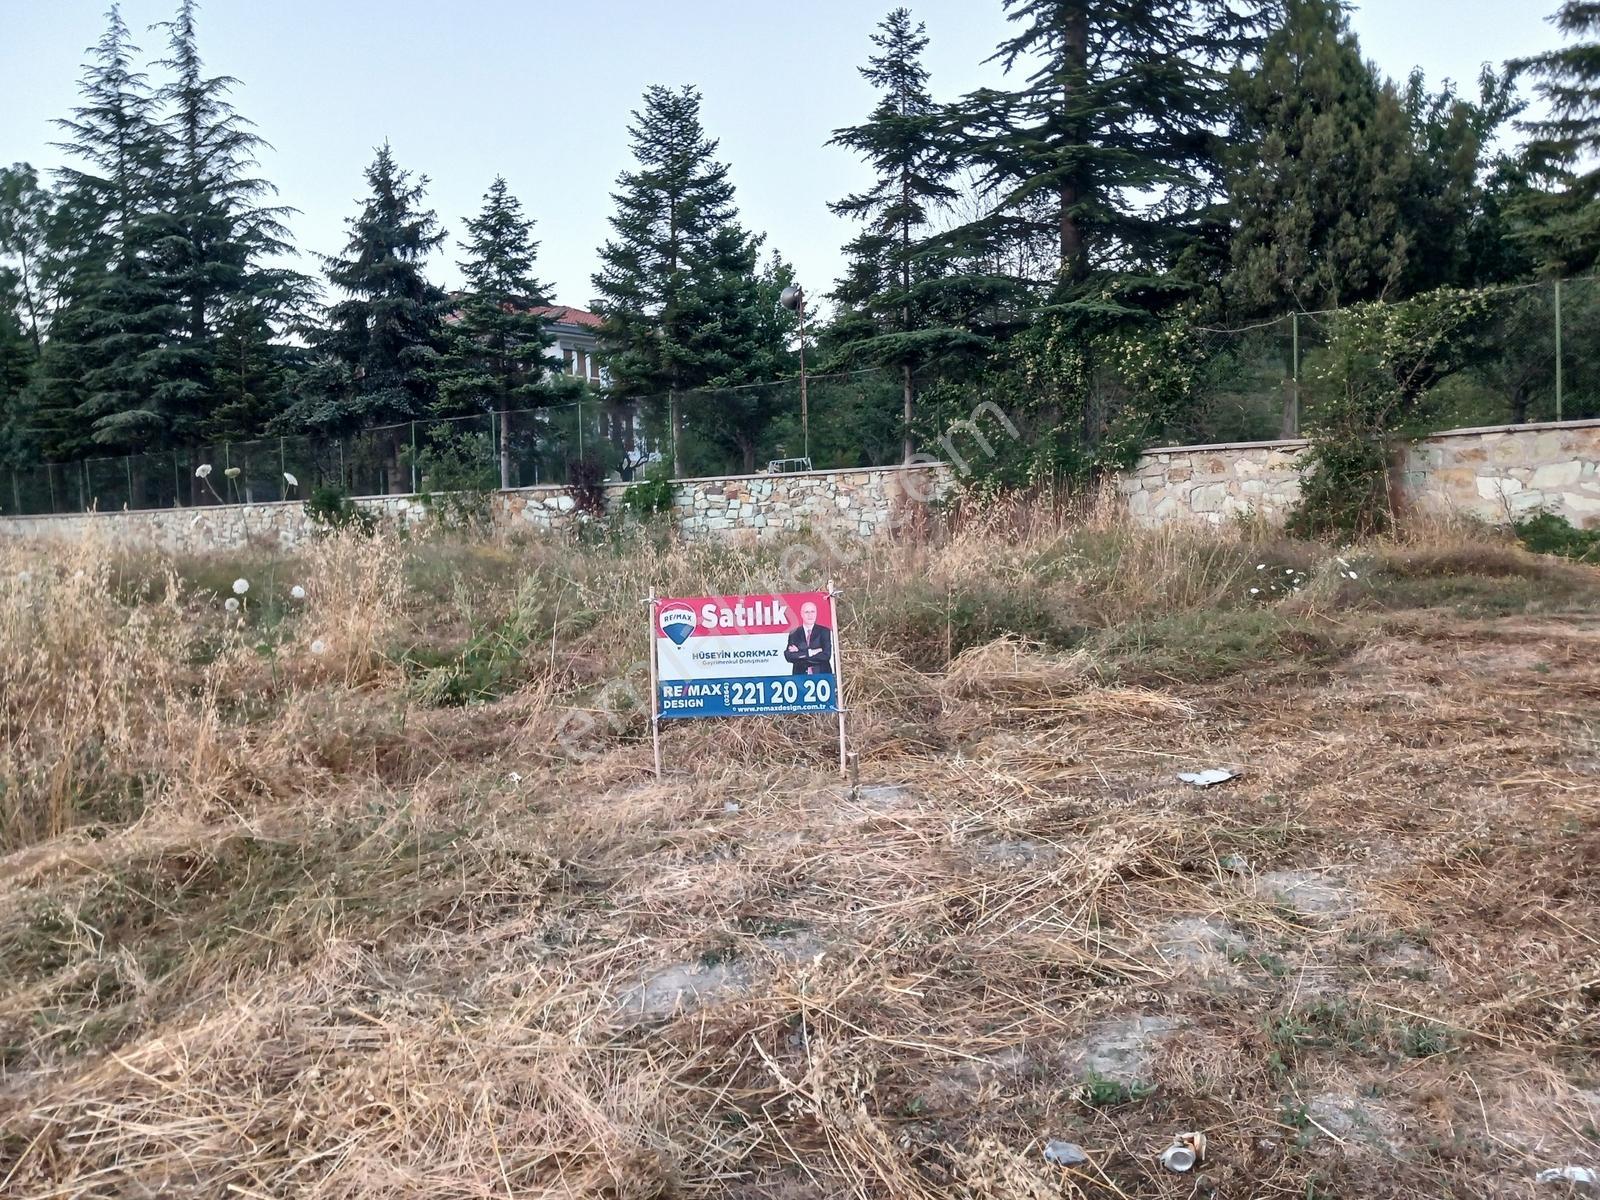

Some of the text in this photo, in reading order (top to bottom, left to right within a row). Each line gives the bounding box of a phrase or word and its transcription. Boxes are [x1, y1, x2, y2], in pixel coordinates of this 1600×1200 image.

[664, 613, 692, 622] RE/MAX
[702, 600, 789, 629] Satılık
[692, 649, 779, 660] HÜSEYİN KORKMAZ
[663, 683, 722, 698] RE/MAX
[731, 679, 831, 705] 221 20 20
[663, 698, 704, 709] DESIGN
[737, 704, 826, 713] www.remaxdesign.com.tr
